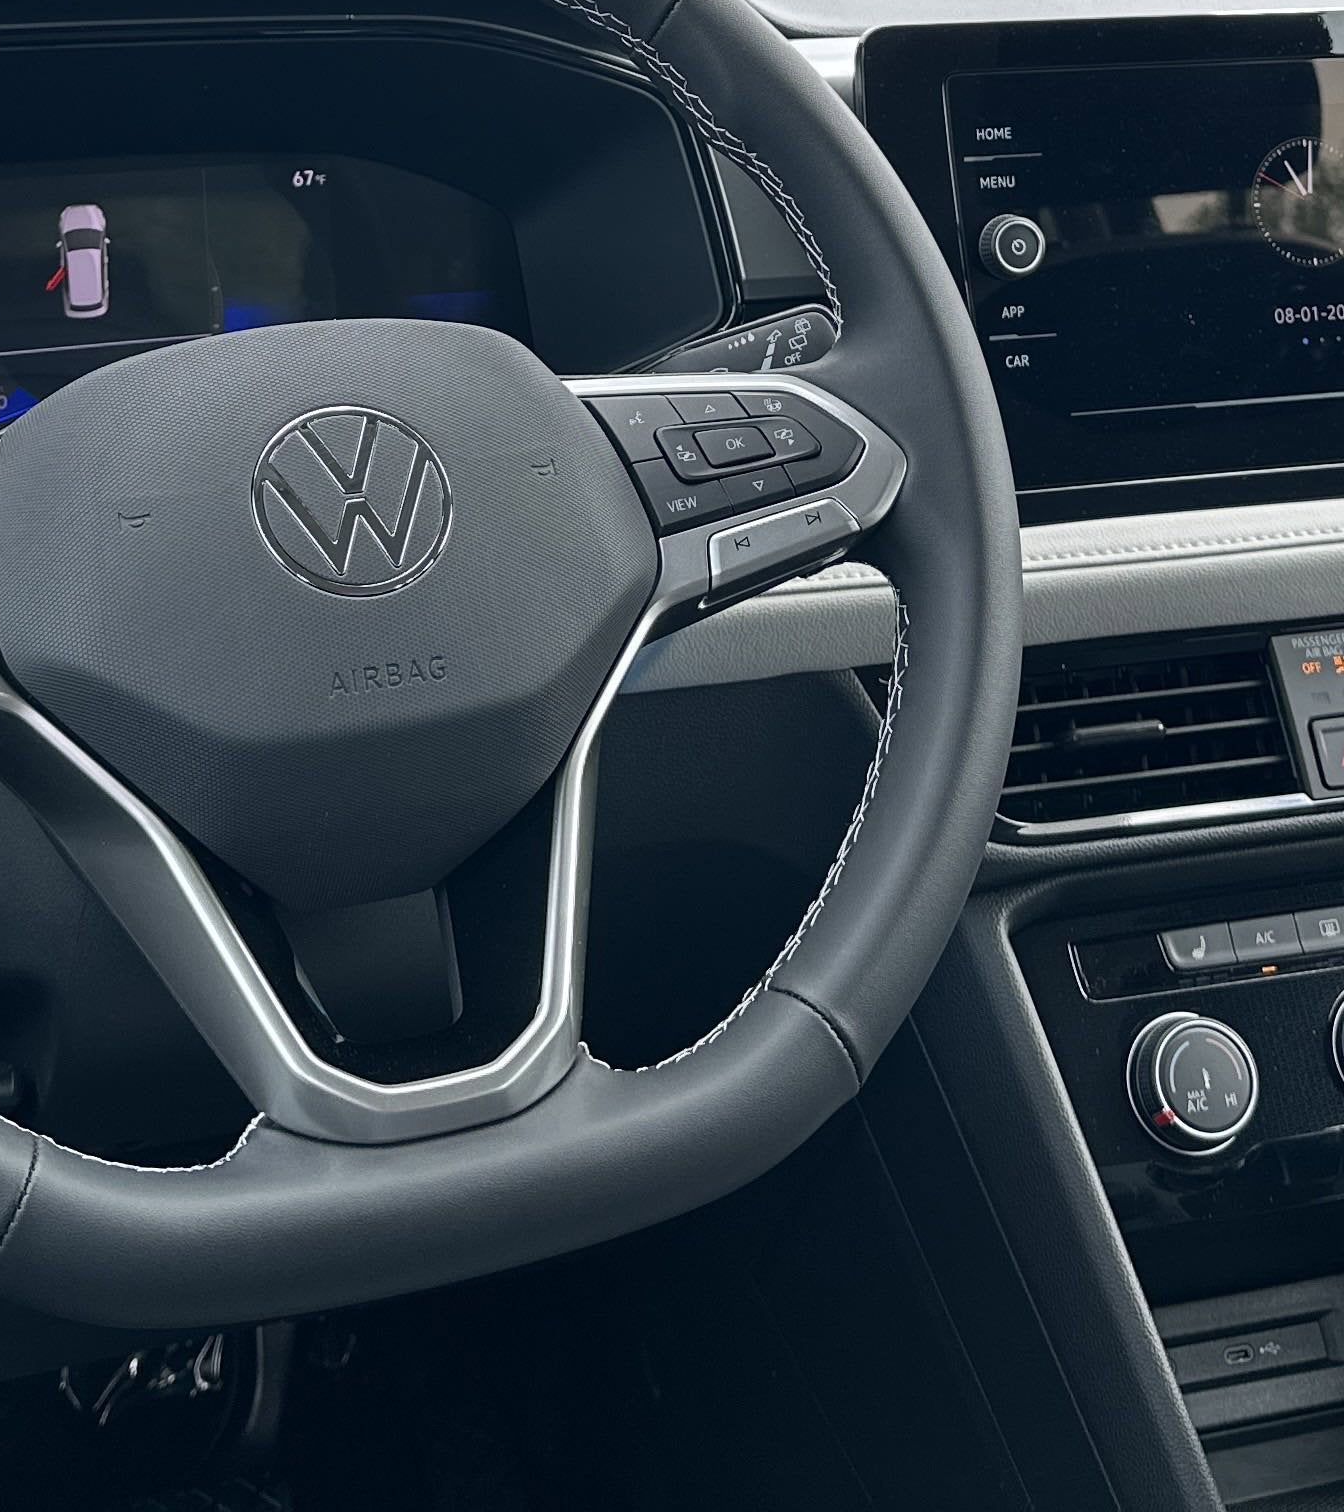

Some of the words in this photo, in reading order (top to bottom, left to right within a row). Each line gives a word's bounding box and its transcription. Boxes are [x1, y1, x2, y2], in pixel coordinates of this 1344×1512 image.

[976, 127, 1012, 140] HOME
[979, 175, 1016, 189] MENU
[1002, 305, 1025, 319] APP
[784, 352, 802, 366] OFF
[1005, 355, 1030, 368] CAR
[725, 438, 745, 450] OK
[667, 496, 698, 513] VIEW
[1302, 662, 1321, 674] OFF
[329, 655, 447, 697] AIRBAG
[1256, 931, 1276, 945] A/C
[1187, 1090, 1205, 1099] MAX
[1187, 1097, 1208, 1113] A/C
